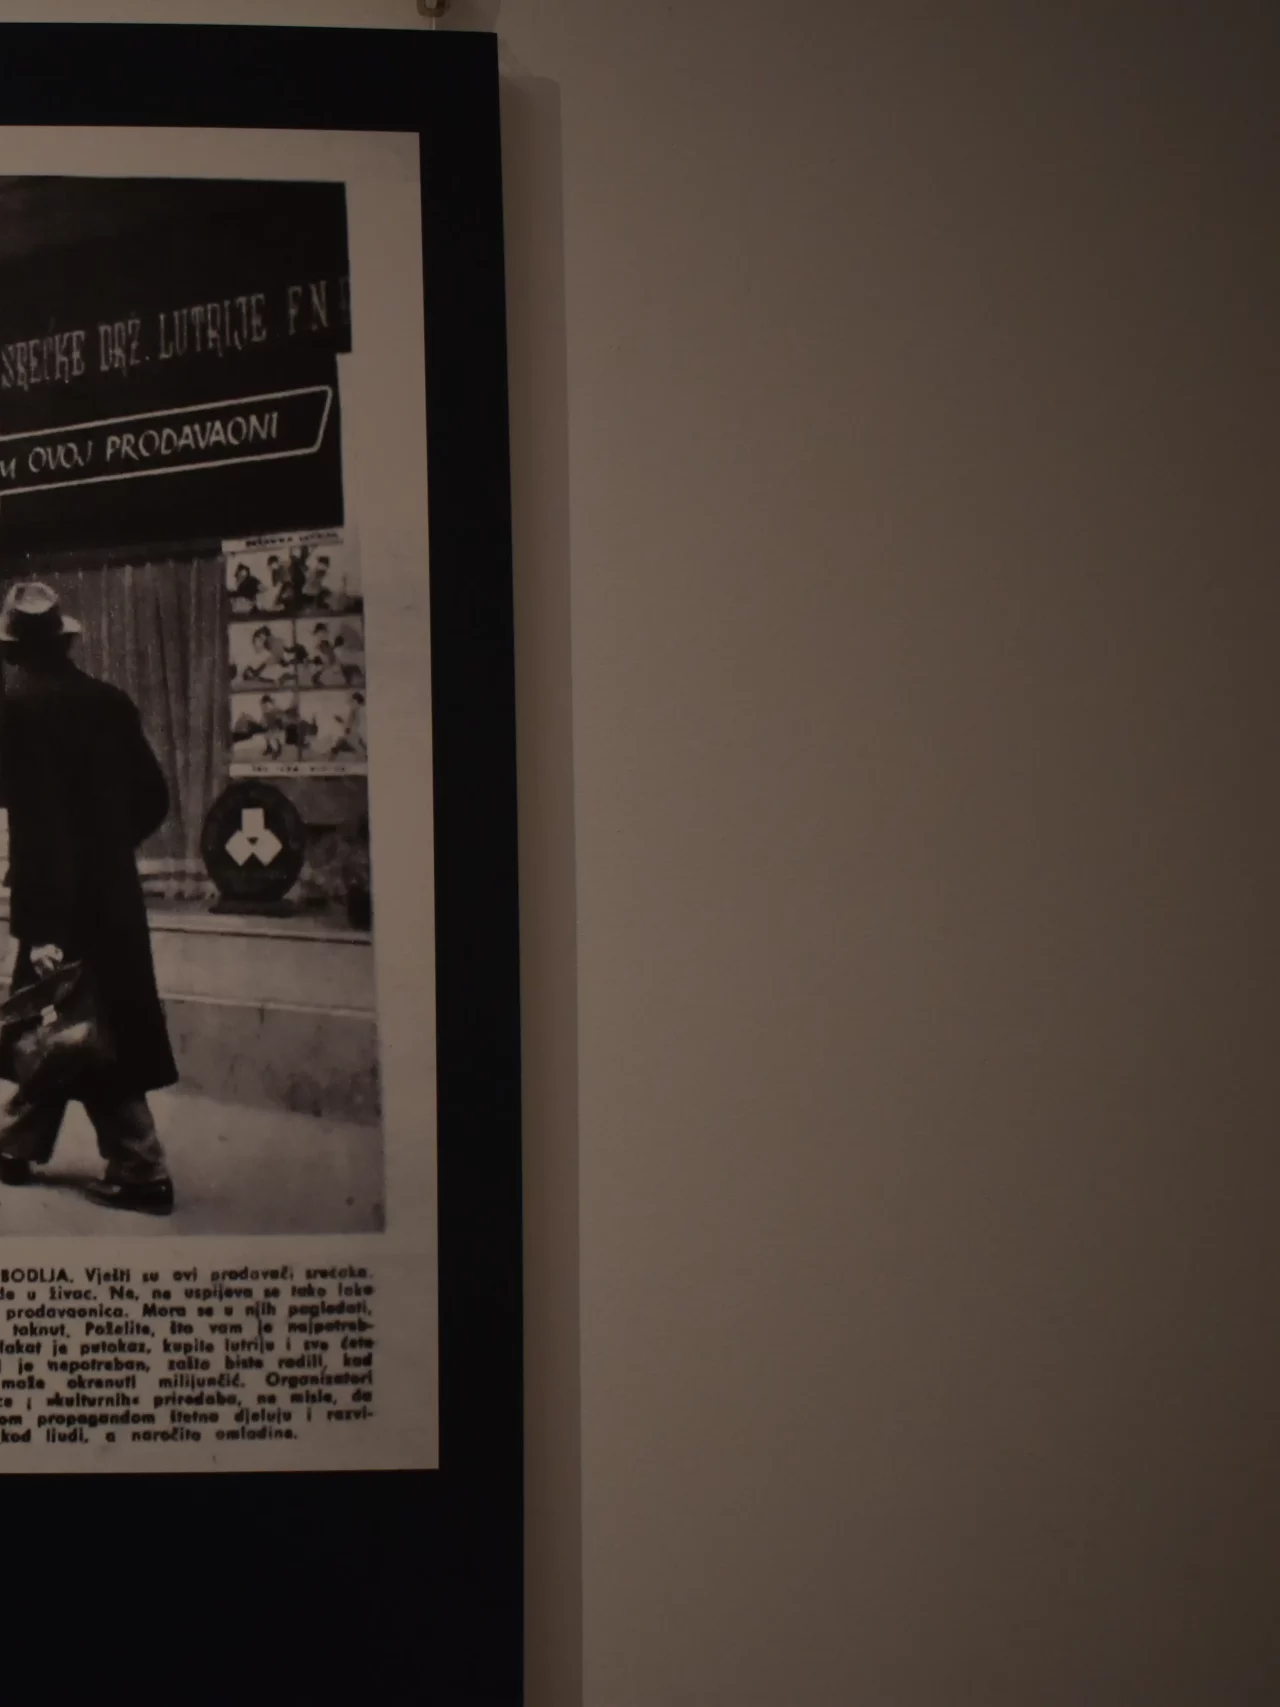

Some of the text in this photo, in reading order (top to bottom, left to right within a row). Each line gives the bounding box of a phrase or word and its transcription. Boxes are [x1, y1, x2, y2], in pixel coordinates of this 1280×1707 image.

[158, 293, 267, 358] LUTRIJE
[28, 440, 93, 474] OVOJ
[104, 412, 279, 463] PRODAVAONI
[142, 1269, 159, 1280] su
[172, 1264, 198, 1279] ovi
[108, 1284, 140, 1302] Ne,
[152, 1288, 172, 1299] ne
[263, 1287, 281, 1298] se
[291, 1283, 327, 1298] tako
[338, 1282, 376, 1297] lako
[142, 1302, 187, 1317] Mora
[197, 1305, 214, 1316] se
[245, 1301, 276, 1319] njih
[170, 1319, 194, 1334] što
[209, 1323, 243, 1334] vam
[257, 1319, 274, 1337] je
[52, 1338, 68, 1356] je
[303, 1340, 329, 1351] sve
[340, 1336, 376, 1351] ćete
[18, 1356, 34, 1374] je
[167, 1354, 211, 1369] zašto
[224, 1354, 264, 1369] biste
[343, 1353, 373, 1368] kad
[1, 1374, 46, 1389] može
[256, 1394, 277, 1405] ne
[351, 1389, 372, 1404] da
[1, 1427, 32, 1442] kod
